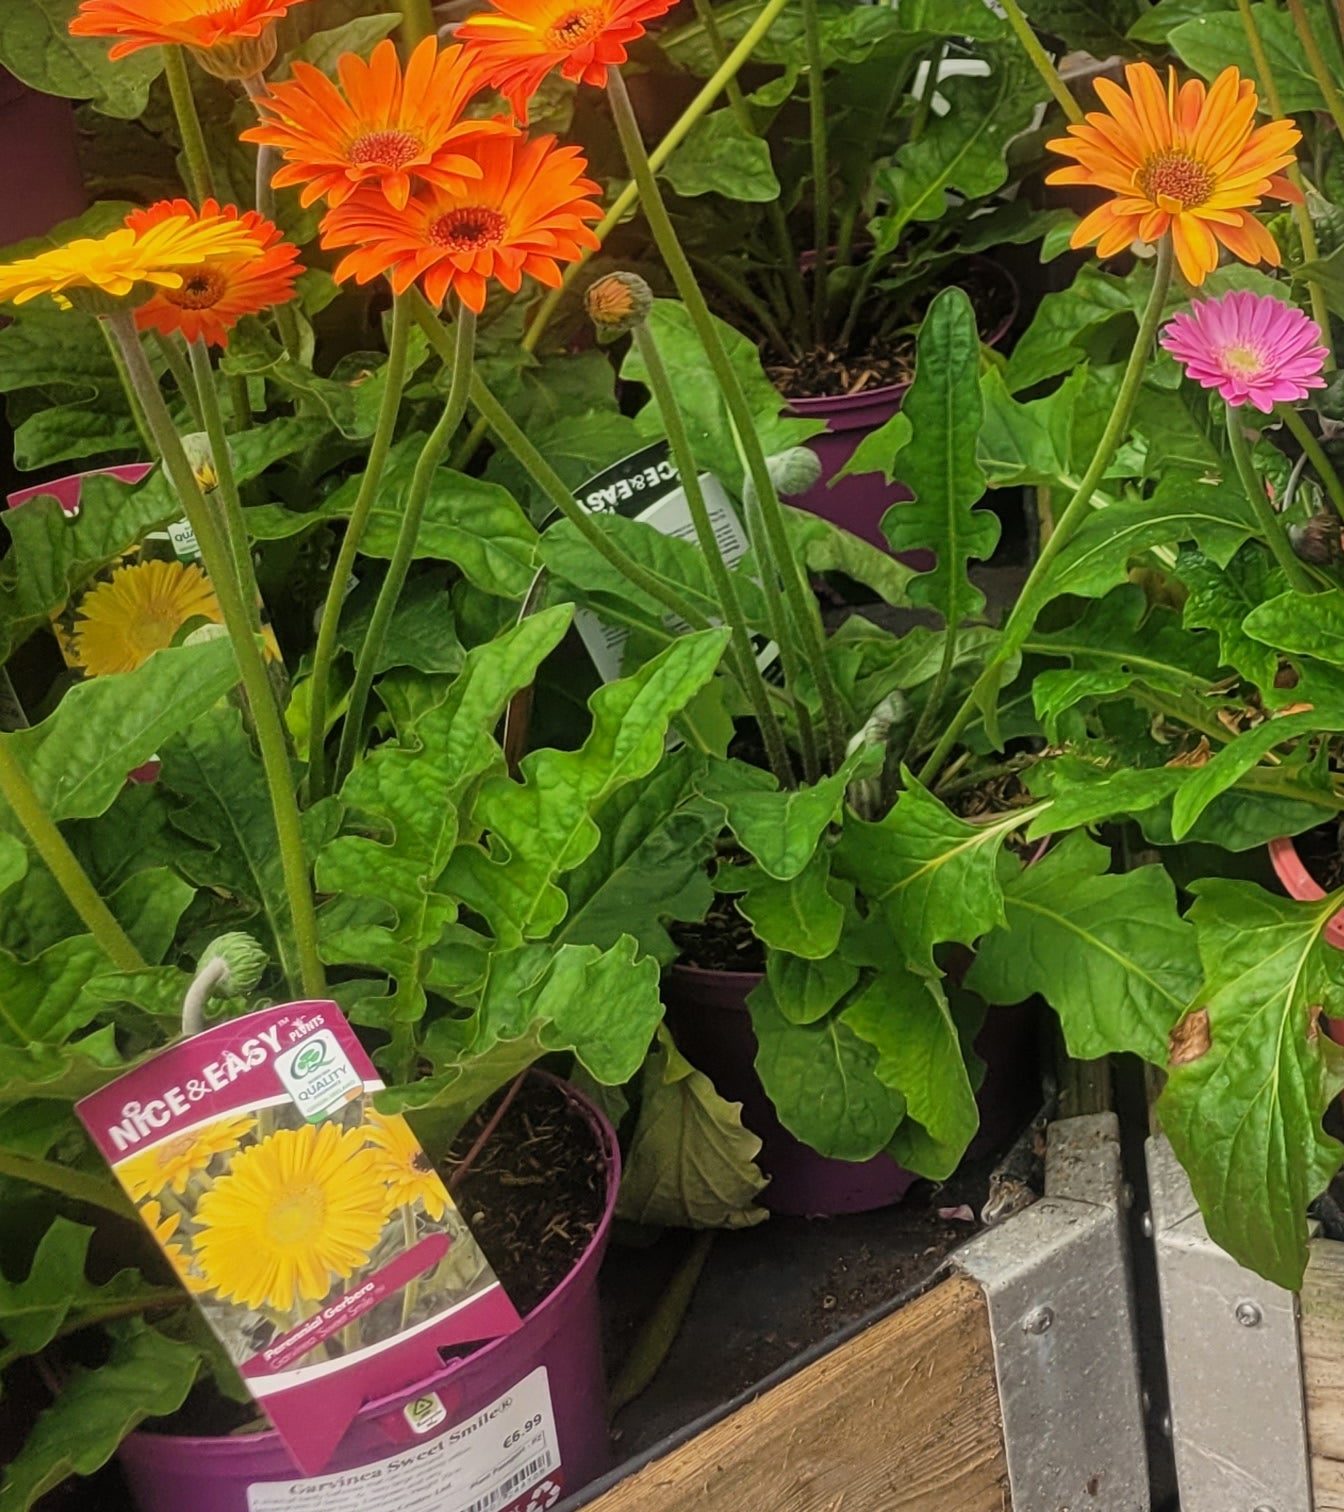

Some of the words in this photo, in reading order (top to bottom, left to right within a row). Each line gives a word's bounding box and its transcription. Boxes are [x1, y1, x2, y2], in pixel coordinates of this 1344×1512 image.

[298, 1064, 349, 1101] QUALITY
[263, 1314, 324, 1361] Perennial
[323, 1282, 376, 1320] Gerbera
[503, 1413, 542, 1449] €6.99
[387, 1441, 444, 1473] Sweet
